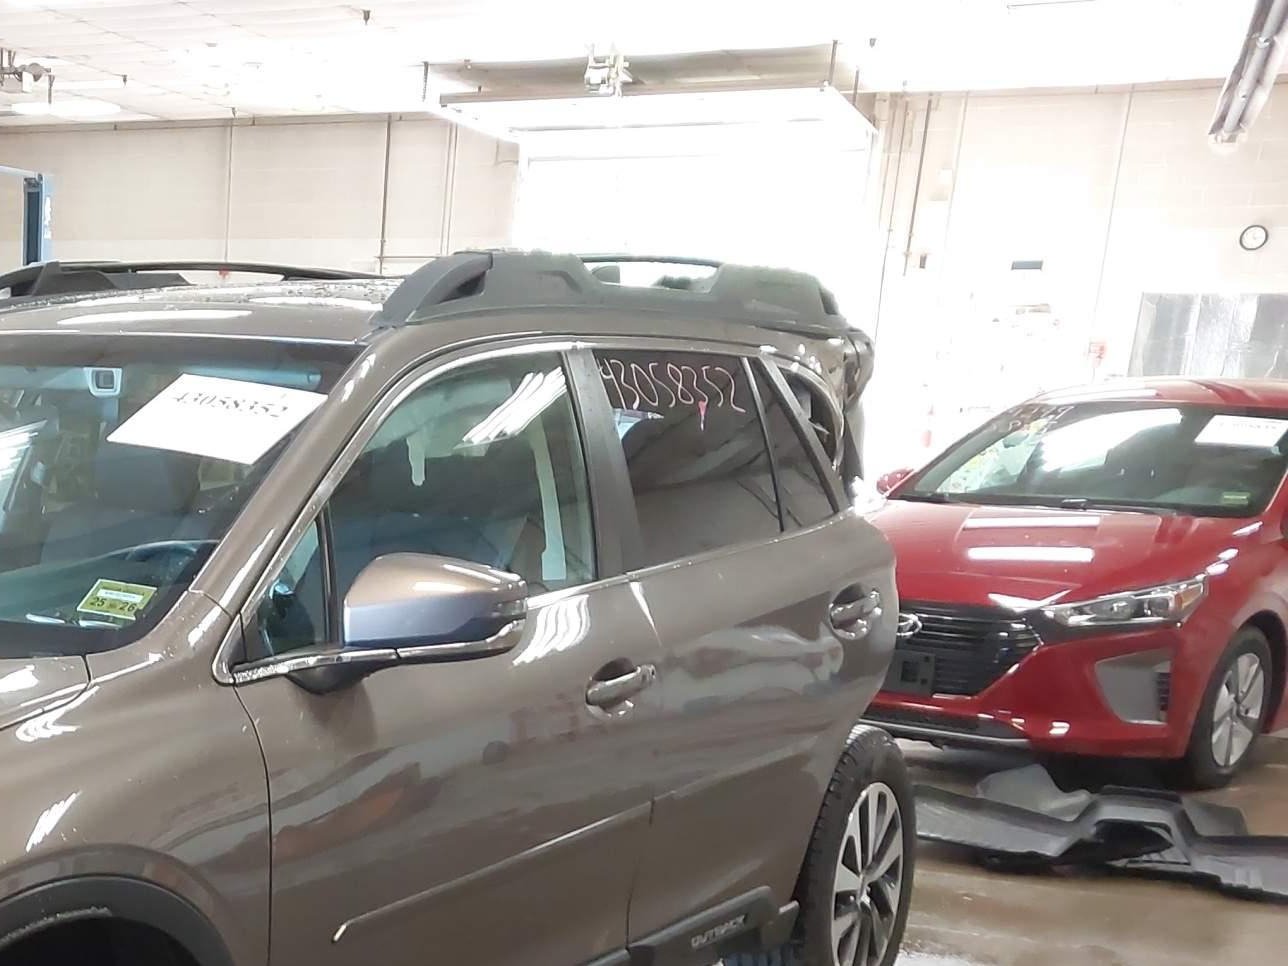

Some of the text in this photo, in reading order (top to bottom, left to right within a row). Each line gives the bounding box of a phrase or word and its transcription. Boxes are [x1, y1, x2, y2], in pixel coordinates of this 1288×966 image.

[599, 358, 746, 413] 43058352
[90, 597, 137, 612] 25 26
